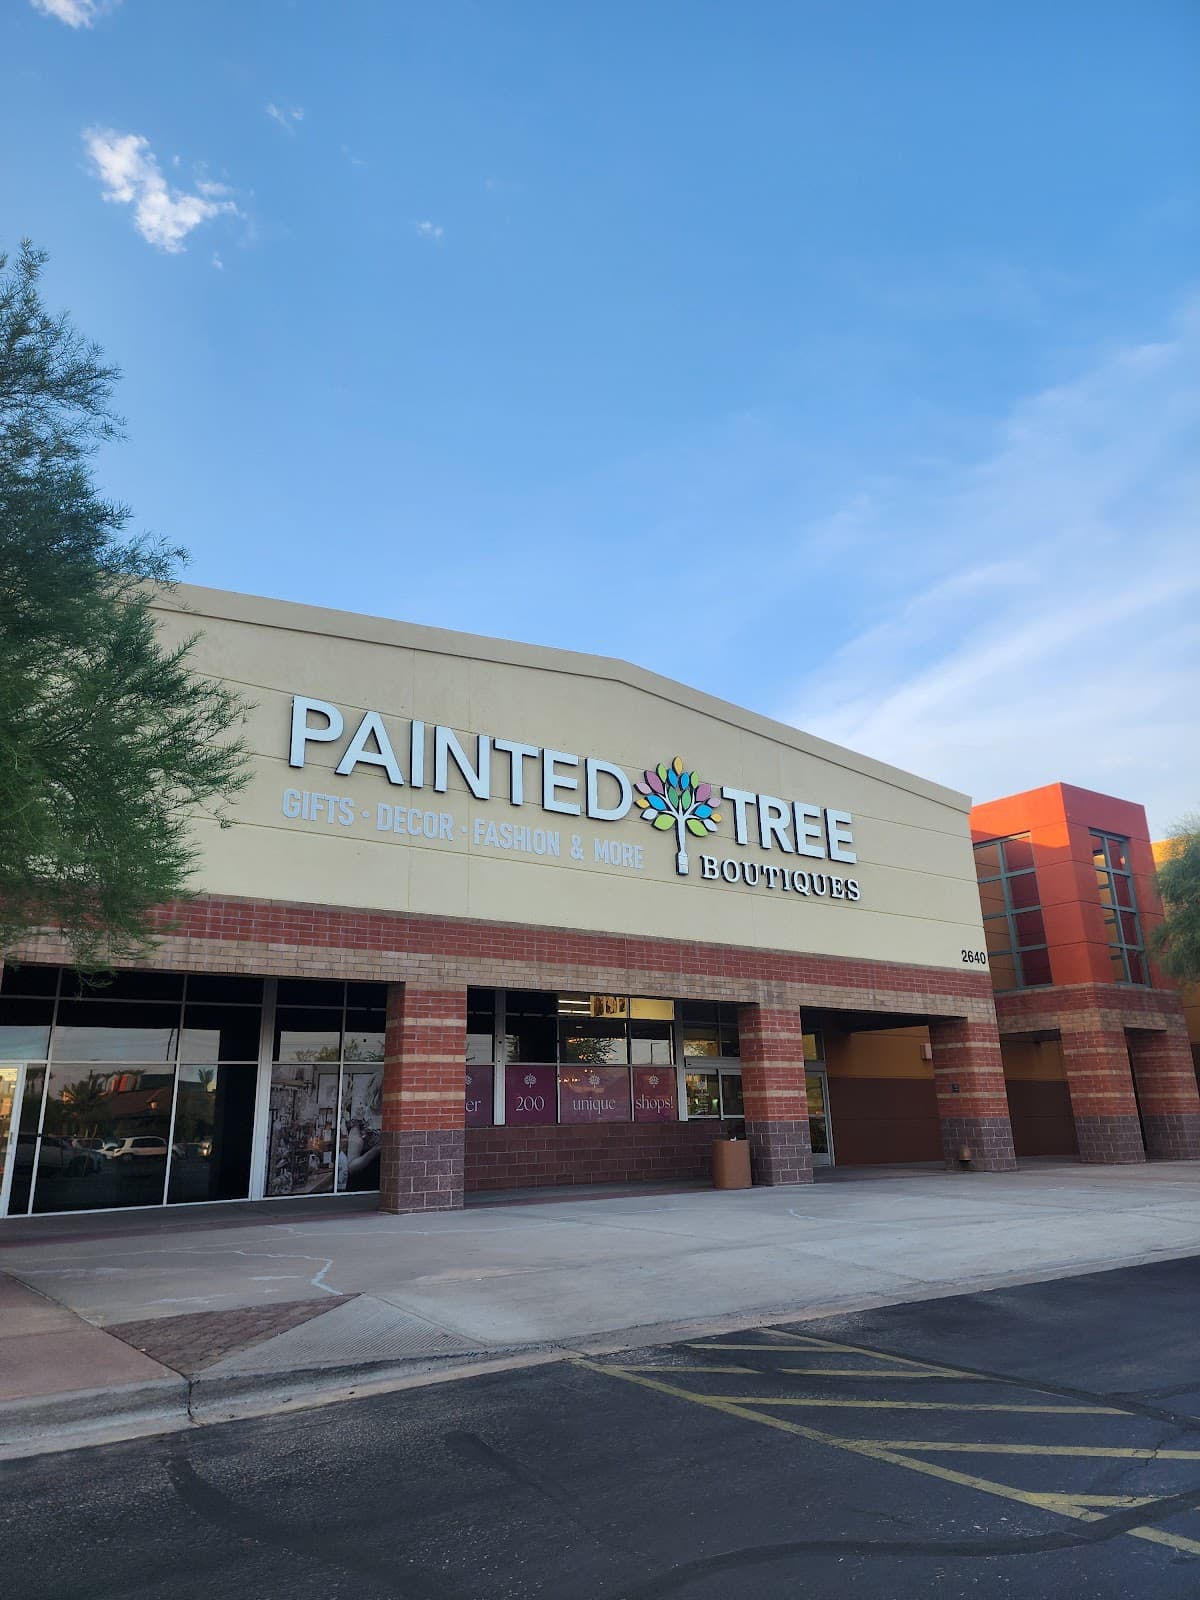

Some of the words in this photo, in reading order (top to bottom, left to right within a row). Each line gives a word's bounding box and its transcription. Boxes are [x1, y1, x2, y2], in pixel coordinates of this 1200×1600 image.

[289, 695, 633, 821] PAINTED
[721, 786, 857, 864] TREE
[282, 788, 355, 826] GIFTS
[376, 803, 454, 841] DECOR
[473, 818, 560, 857] FASHION
[570, 834, 584, 861] &
[594, 838, 644, 870] MORE
[700, 854, 861, 901] BOUTIQUES
[961, 950, 986, 965] 2640
[515, 1096, 545, 1111] 200
[573, 1096, 616, 1114] unique
[635, 1093, 674, 1113] shops!
